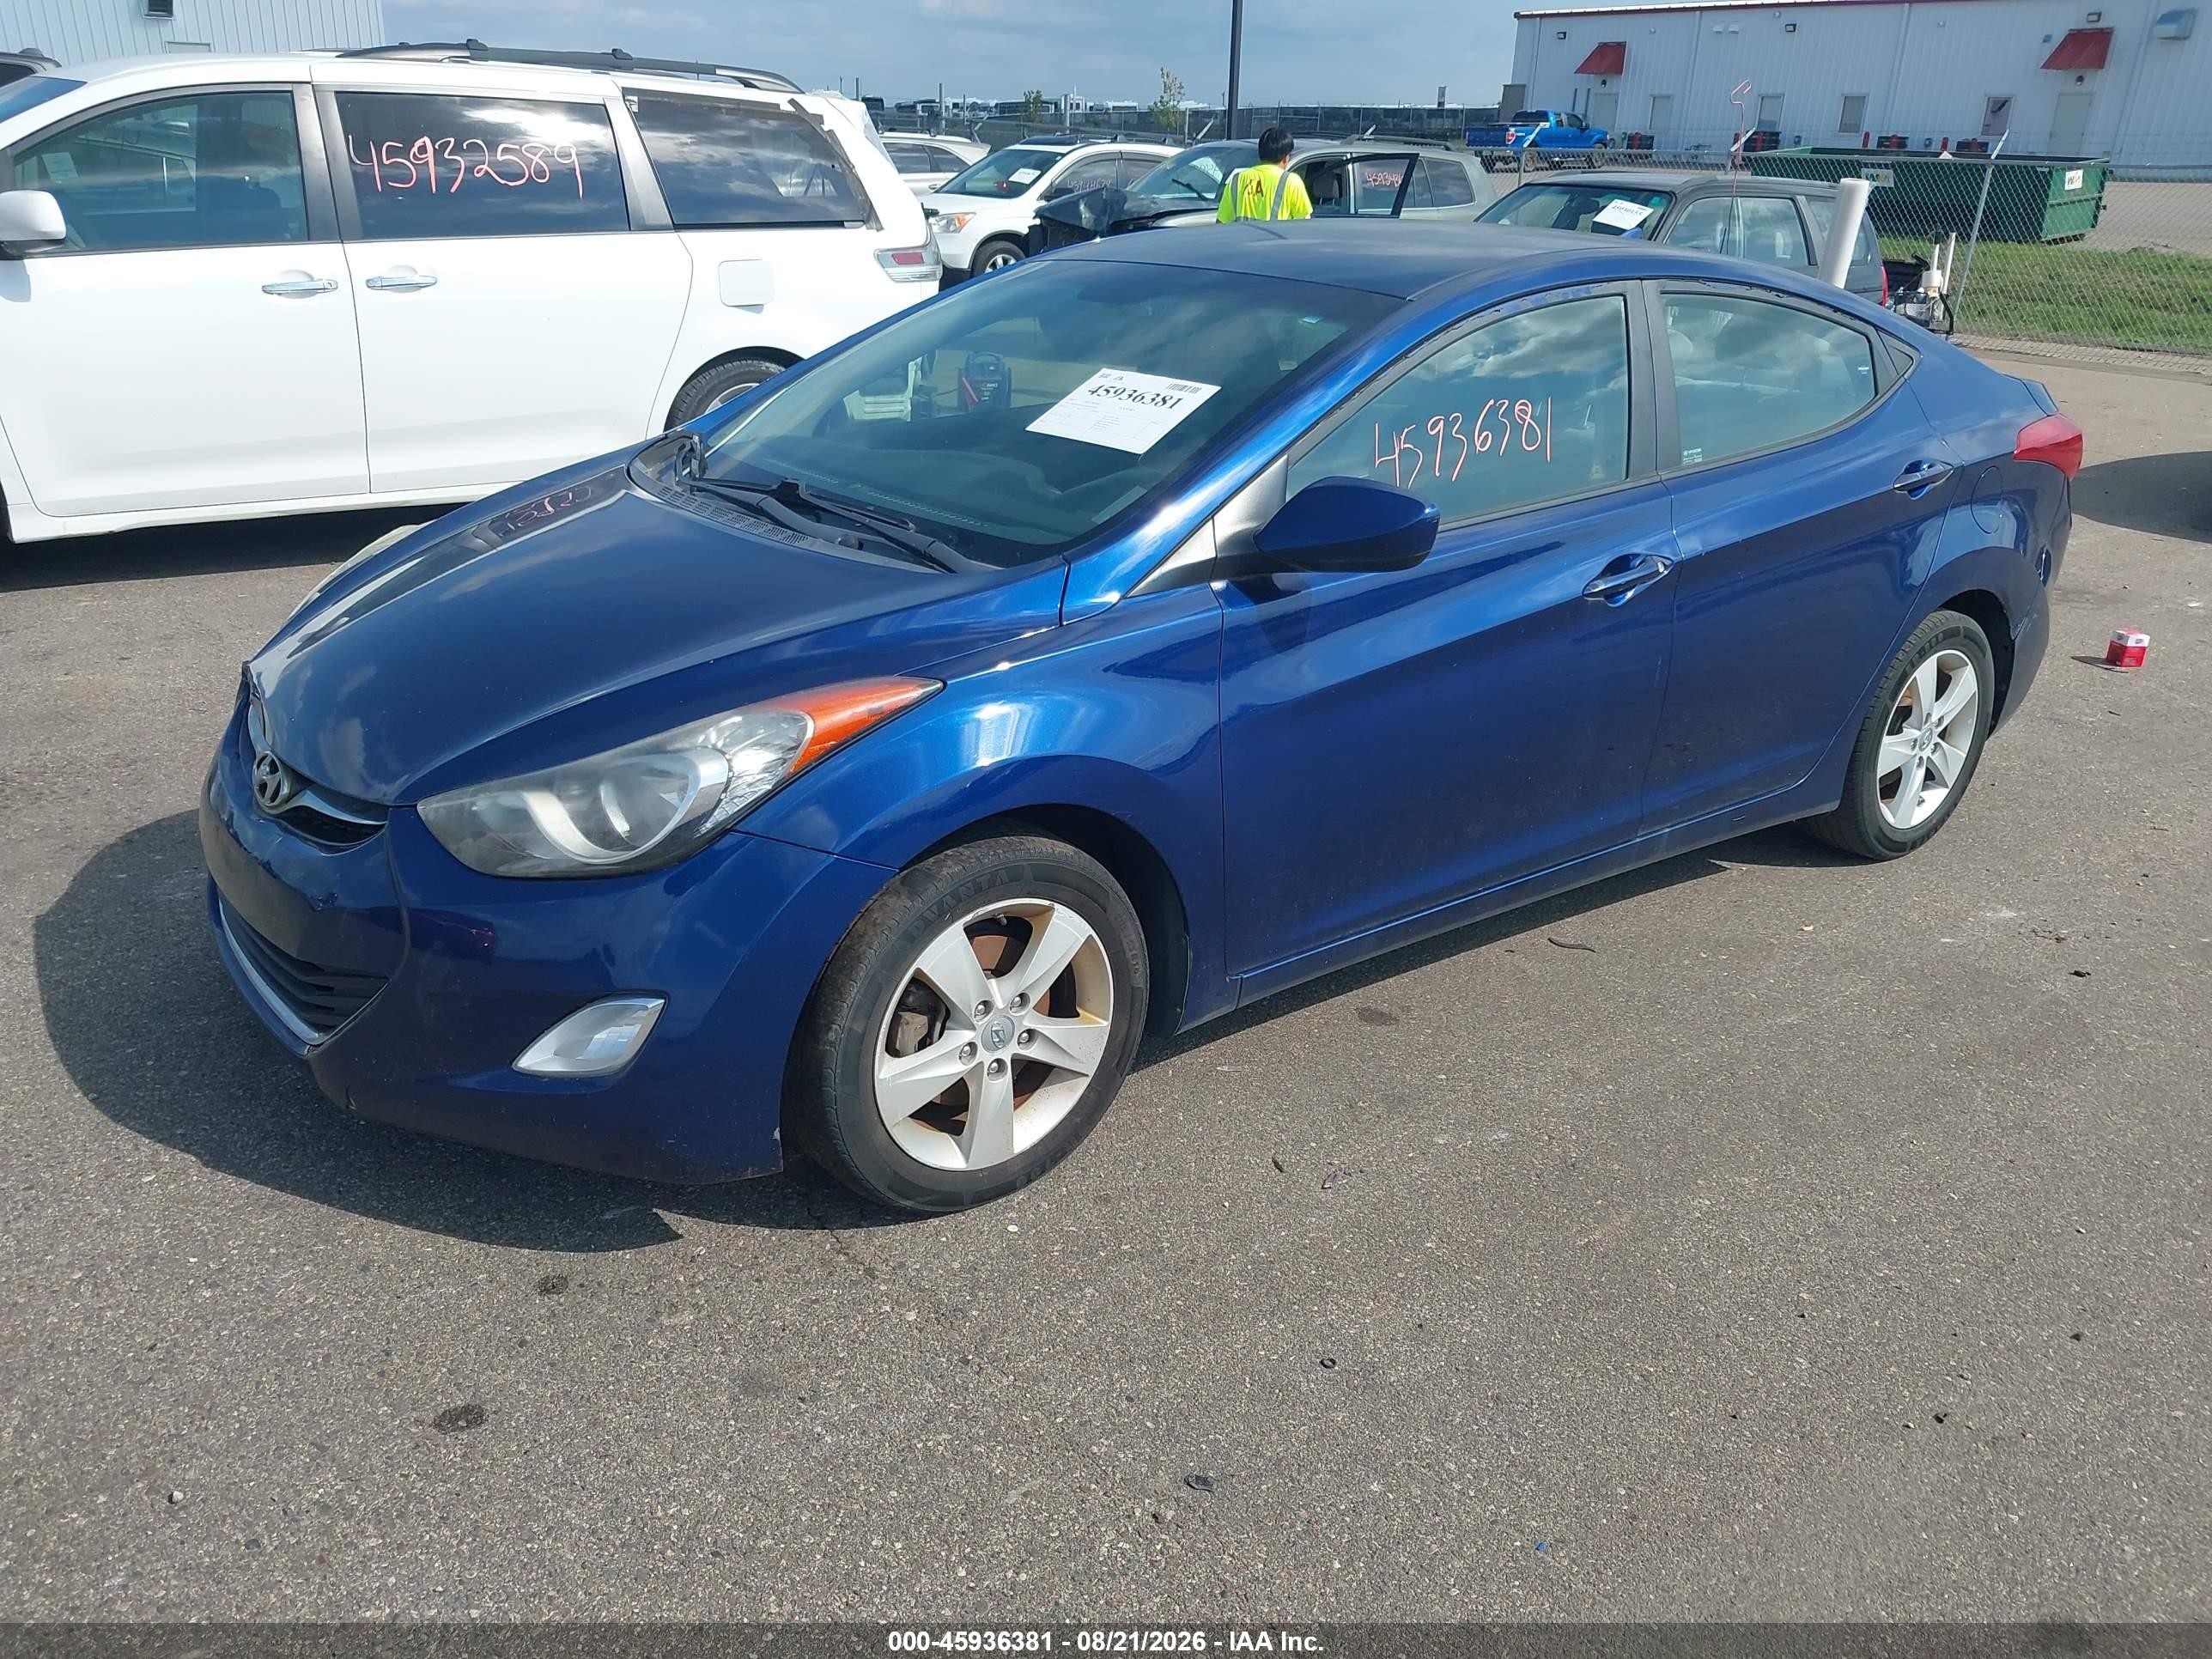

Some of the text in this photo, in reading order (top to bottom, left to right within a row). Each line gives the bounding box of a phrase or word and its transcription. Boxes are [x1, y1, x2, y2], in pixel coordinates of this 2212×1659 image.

[348, 135, 583, 199] 45932589
[1088, 384, 1183, 410] 45936381
[1375, 397, 1552, 489] 45936381
